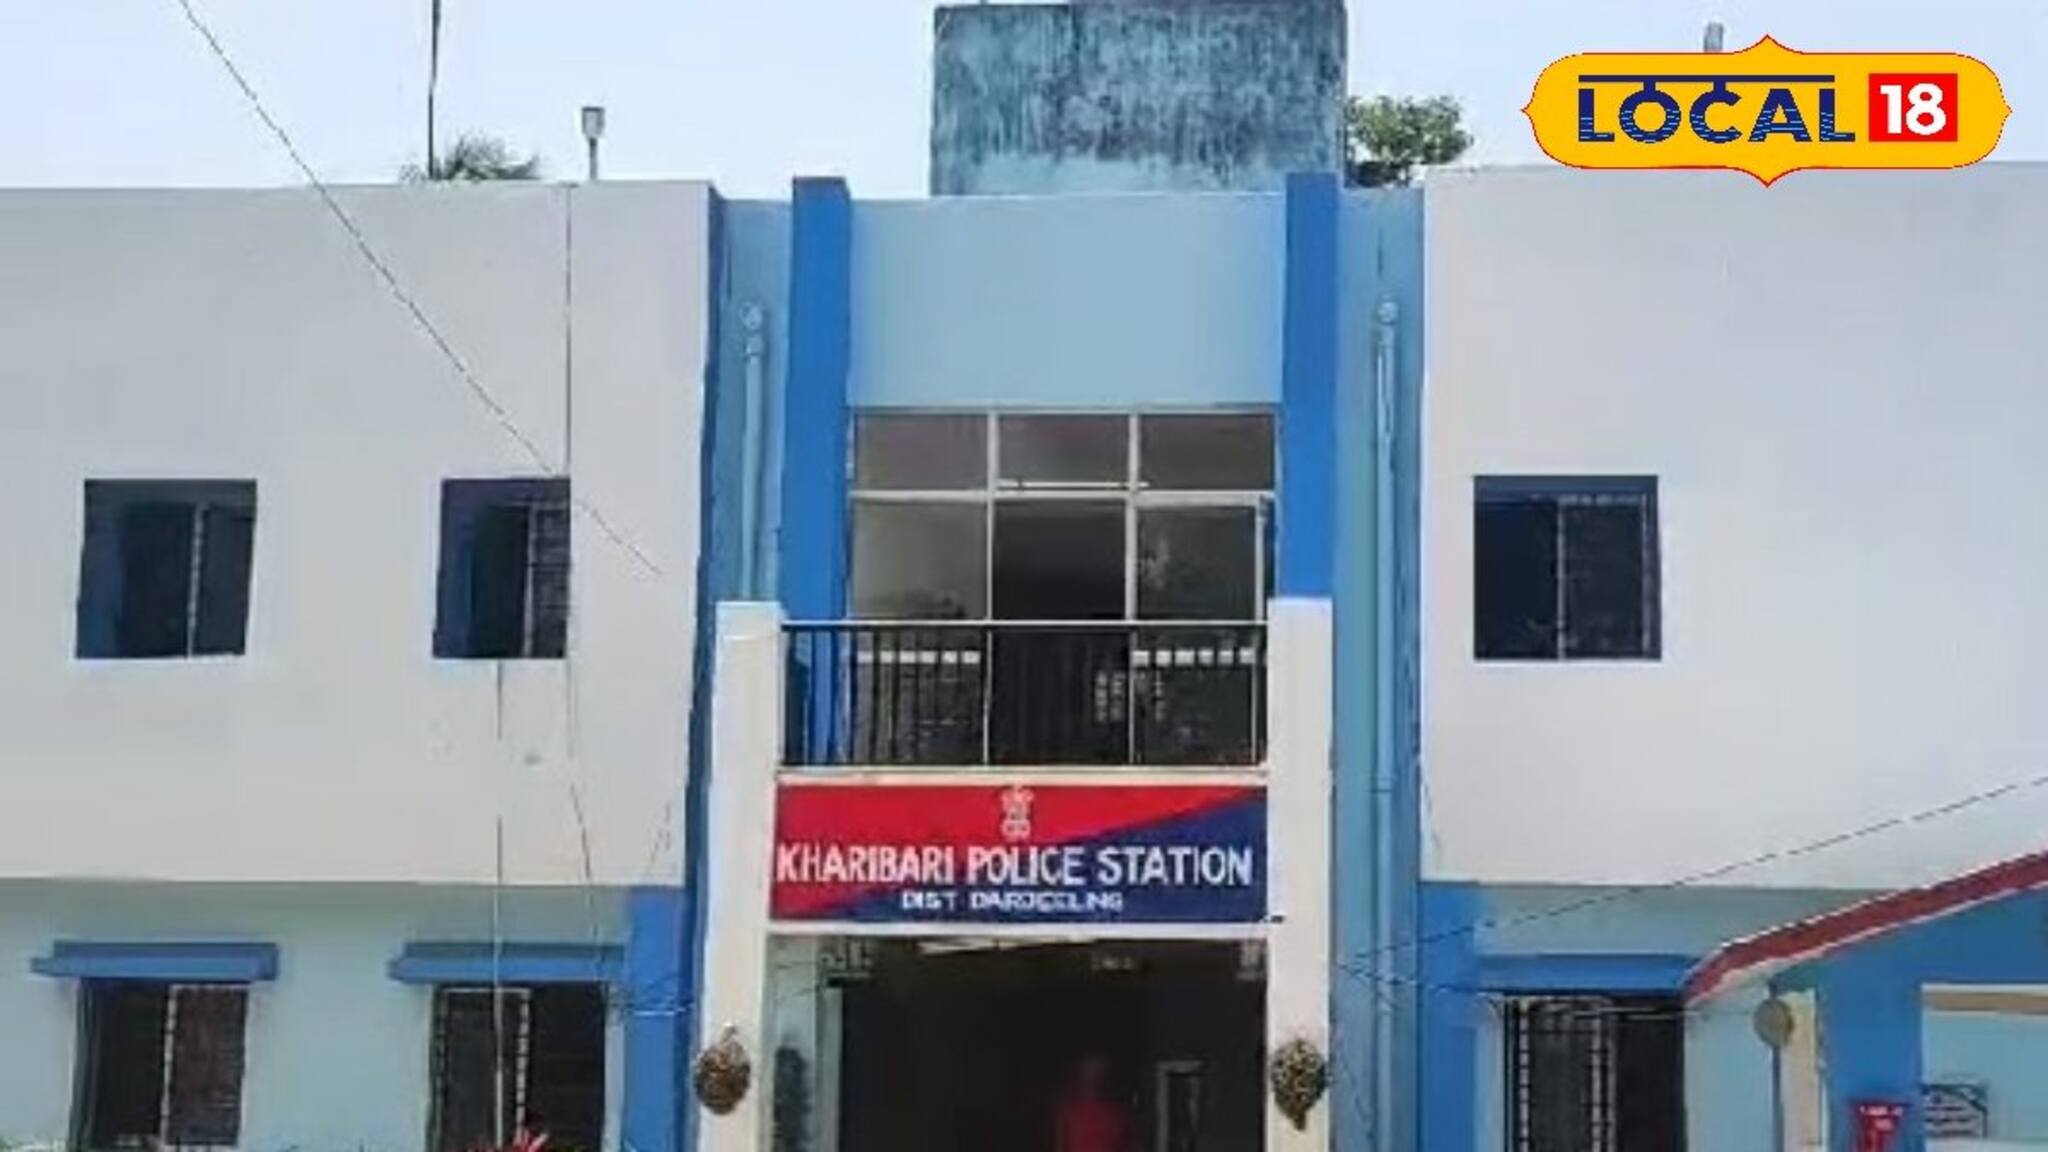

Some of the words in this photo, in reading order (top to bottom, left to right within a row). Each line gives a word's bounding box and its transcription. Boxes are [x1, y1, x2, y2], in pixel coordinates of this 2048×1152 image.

[776, 843, 954, 884] KHARIBARI
[967, 845, 1084, 886] POLICE
[1099, 846, 1252, 886] STATION
